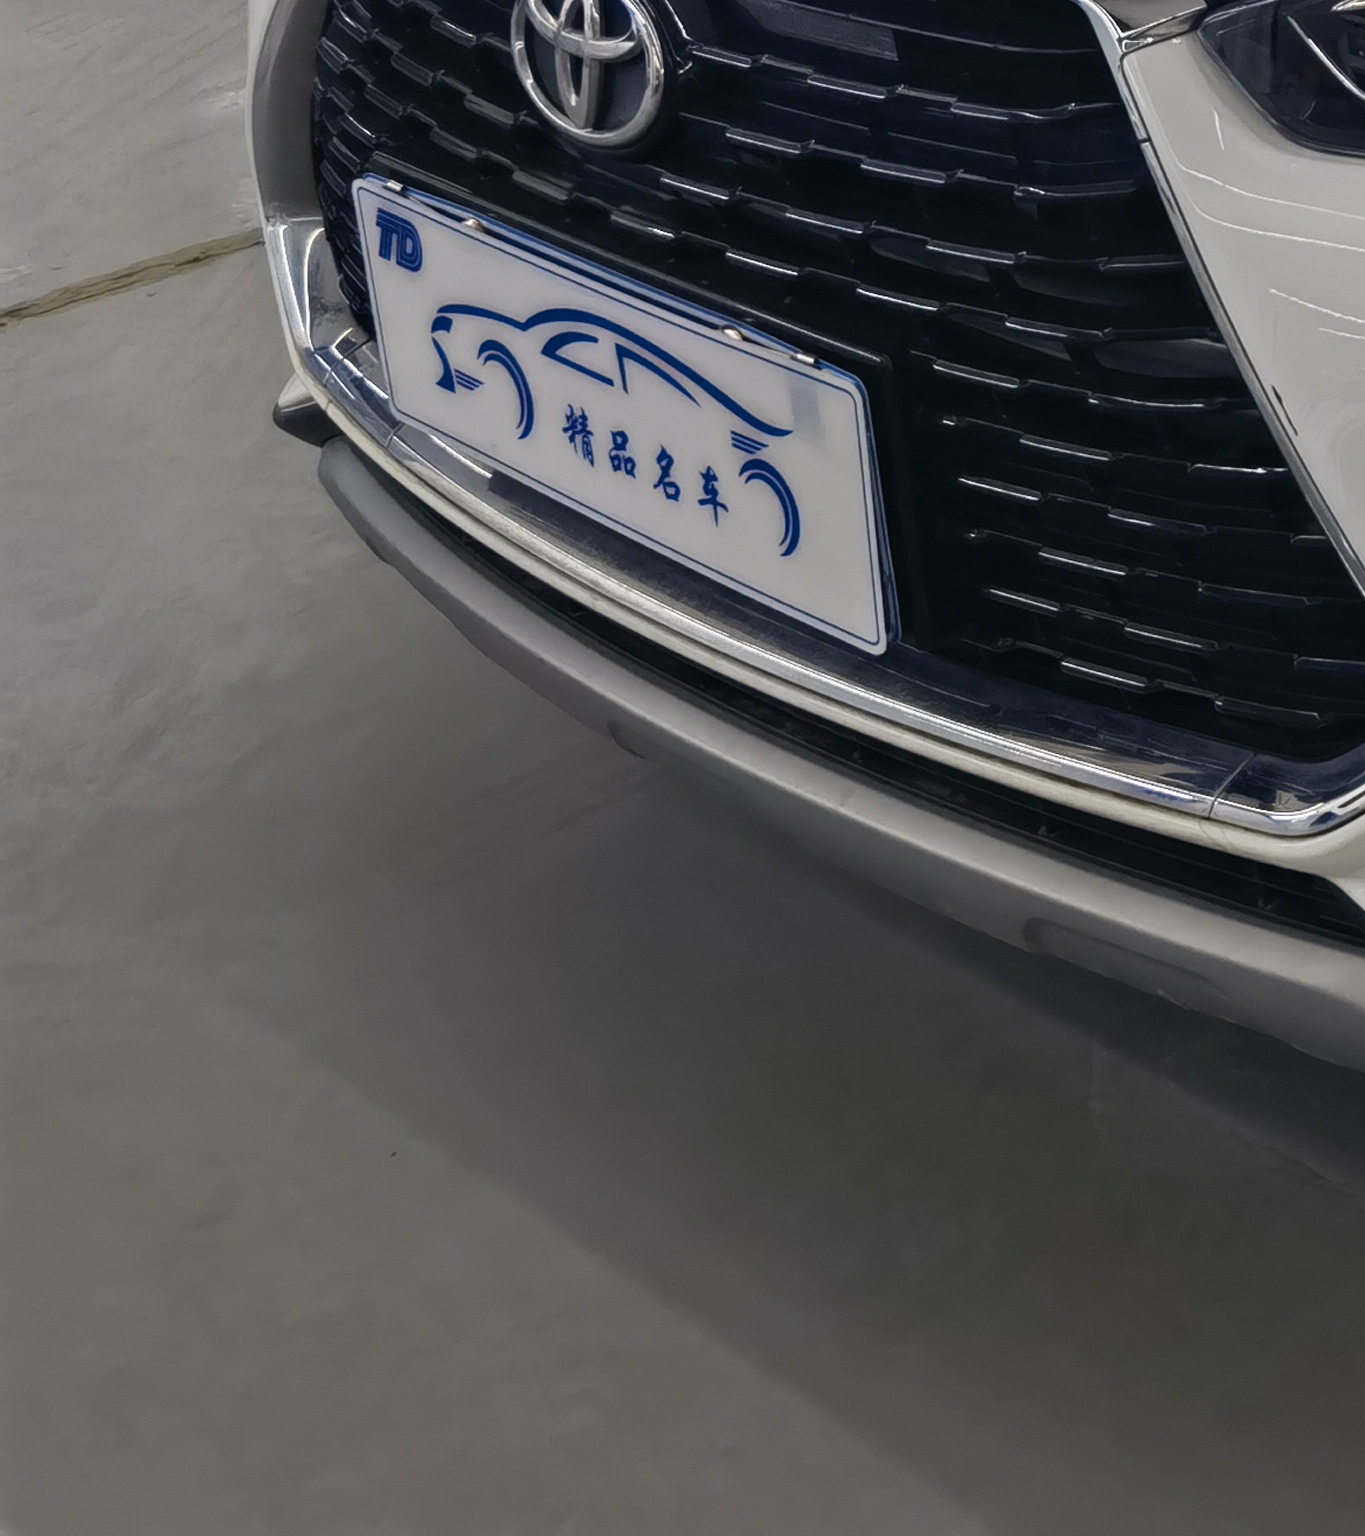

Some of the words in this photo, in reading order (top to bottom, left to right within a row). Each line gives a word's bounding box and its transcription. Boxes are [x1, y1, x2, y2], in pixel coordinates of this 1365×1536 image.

[376, 207, 423, 273] TD
[562, 404, 729, 527] 精品名车
